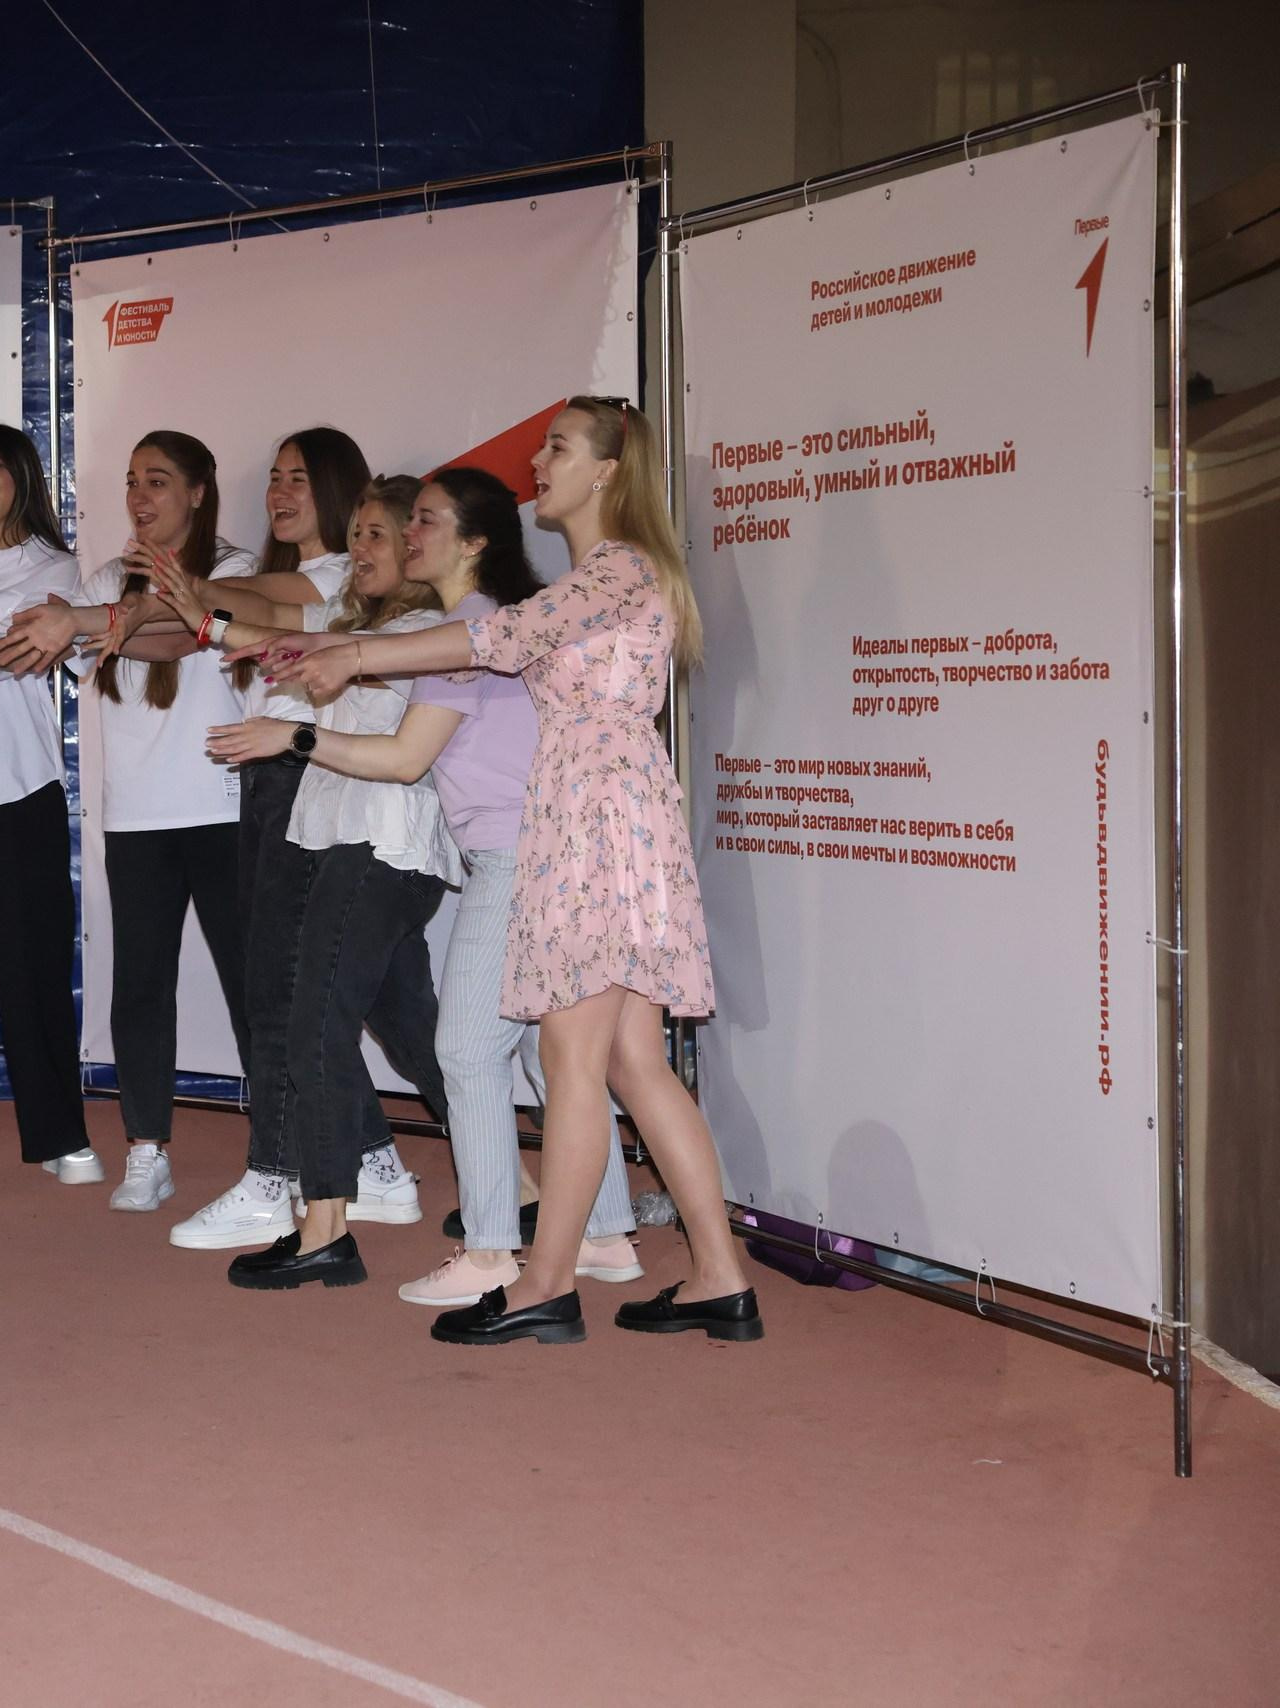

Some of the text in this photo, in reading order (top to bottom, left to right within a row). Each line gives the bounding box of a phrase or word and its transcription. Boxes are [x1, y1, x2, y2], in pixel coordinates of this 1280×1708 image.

[1075, 215, 1109, 237] Первые
[811, 250, 977, 299] Российское движение
[118, 317, 152, 330] ДЕТСТВА
[120, 303, 169, 315] ФЕСТИВАЛЬ
[811, 286, 943, 331] детей и молодежи
[123, 331, 156, 341] ЮНОСТИ
[712, 438, 783, 471] Первые
[802, 430, 832, 457] это
[837, 410, 935, 451] сильный,
[713, 442, 1015, 511] здоровый, умный и отважный
[713, 514, 790, 551] ребёнок
[853, 635, 908, 658] Идеалы
[912, 636, 968, 659] первых
[984, 628, 1057, 656] доброта,
[853, 658, 1109, 687] открытость, творчество и забота
[853, 695, 938, 716] друг о друге
[715, 754, 760, 775] Первые
[774, 758, 795, 774] это
[798, 760, 824, 779] мир
[827, 760, 870, 777] новых
[873, 758, 931, 782] знаний,
[717, 783, 853, 806] дружбы и творчества,
[717, 808, 1013, 841] мир, который заставляет нас верить в себя
[717, 836, 1016, 871] и в свои силы, в свои мечты и возможности
[1095, 738, 1111, 1096] будьвдвижении.рф
